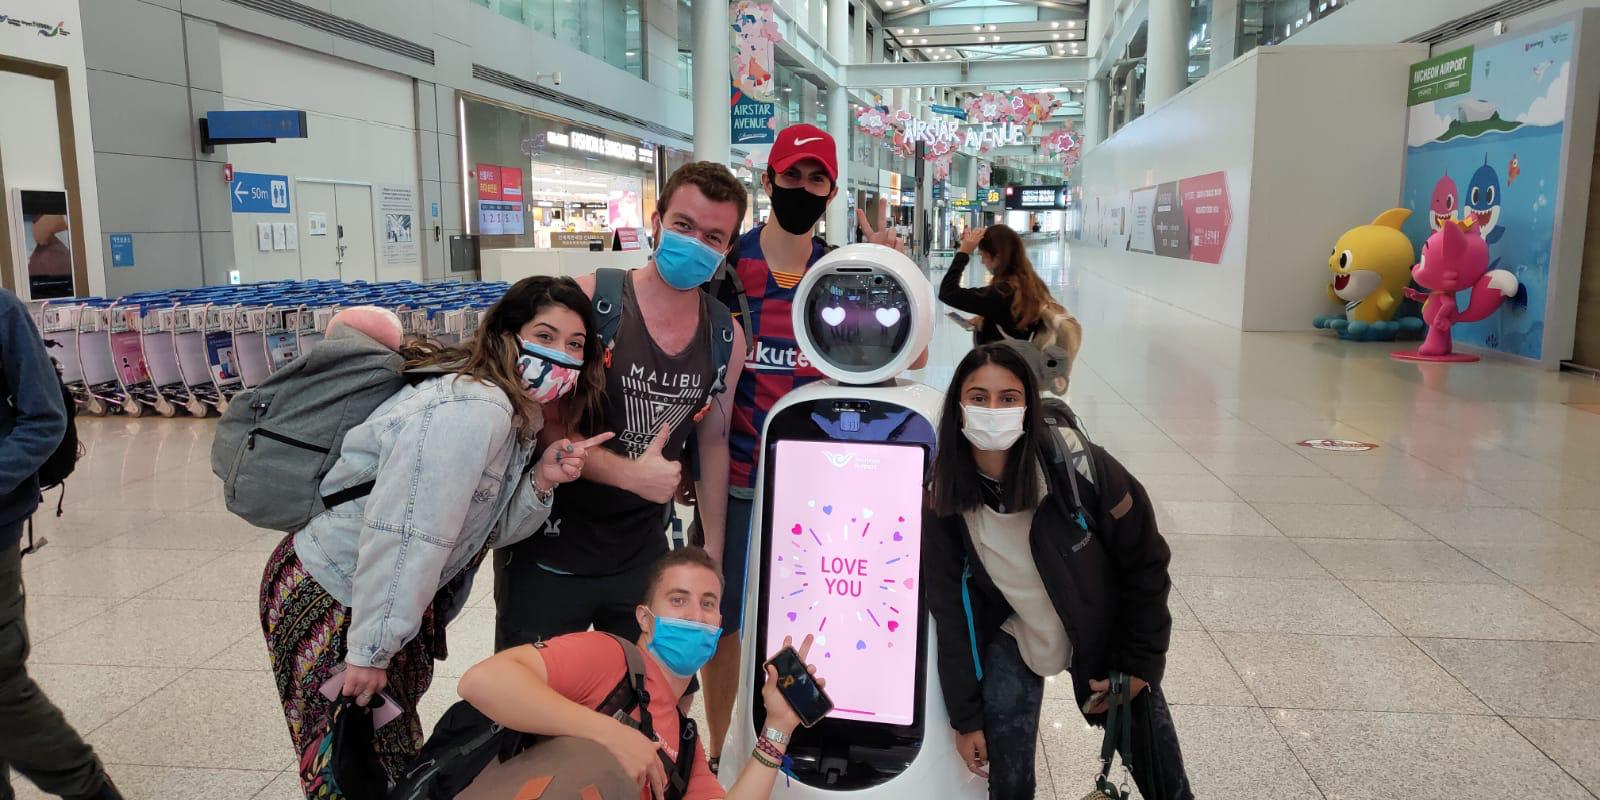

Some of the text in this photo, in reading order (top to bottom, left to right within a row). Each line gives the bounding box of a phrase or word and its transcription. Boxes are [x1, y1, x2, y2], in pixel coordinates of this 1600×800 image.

[1413, 56, 1467, 84] INCHEON AIRPORT
[734, 104, 772, 116] AIRSTAR
[734, 117, 767, 129] AVENUE
[903, 117, 1024, 150] AIRSTAR AVENUE
[251, 187, 269, 200] 50m
[630, 362, 701, 388] MALIBU
[622, 388, 698, 405] CALIFORNIA
[624, 432, 655, 444] OCE
[821, 556, 868, 576] LOVE
[825, 577, 861, 597] YOU
